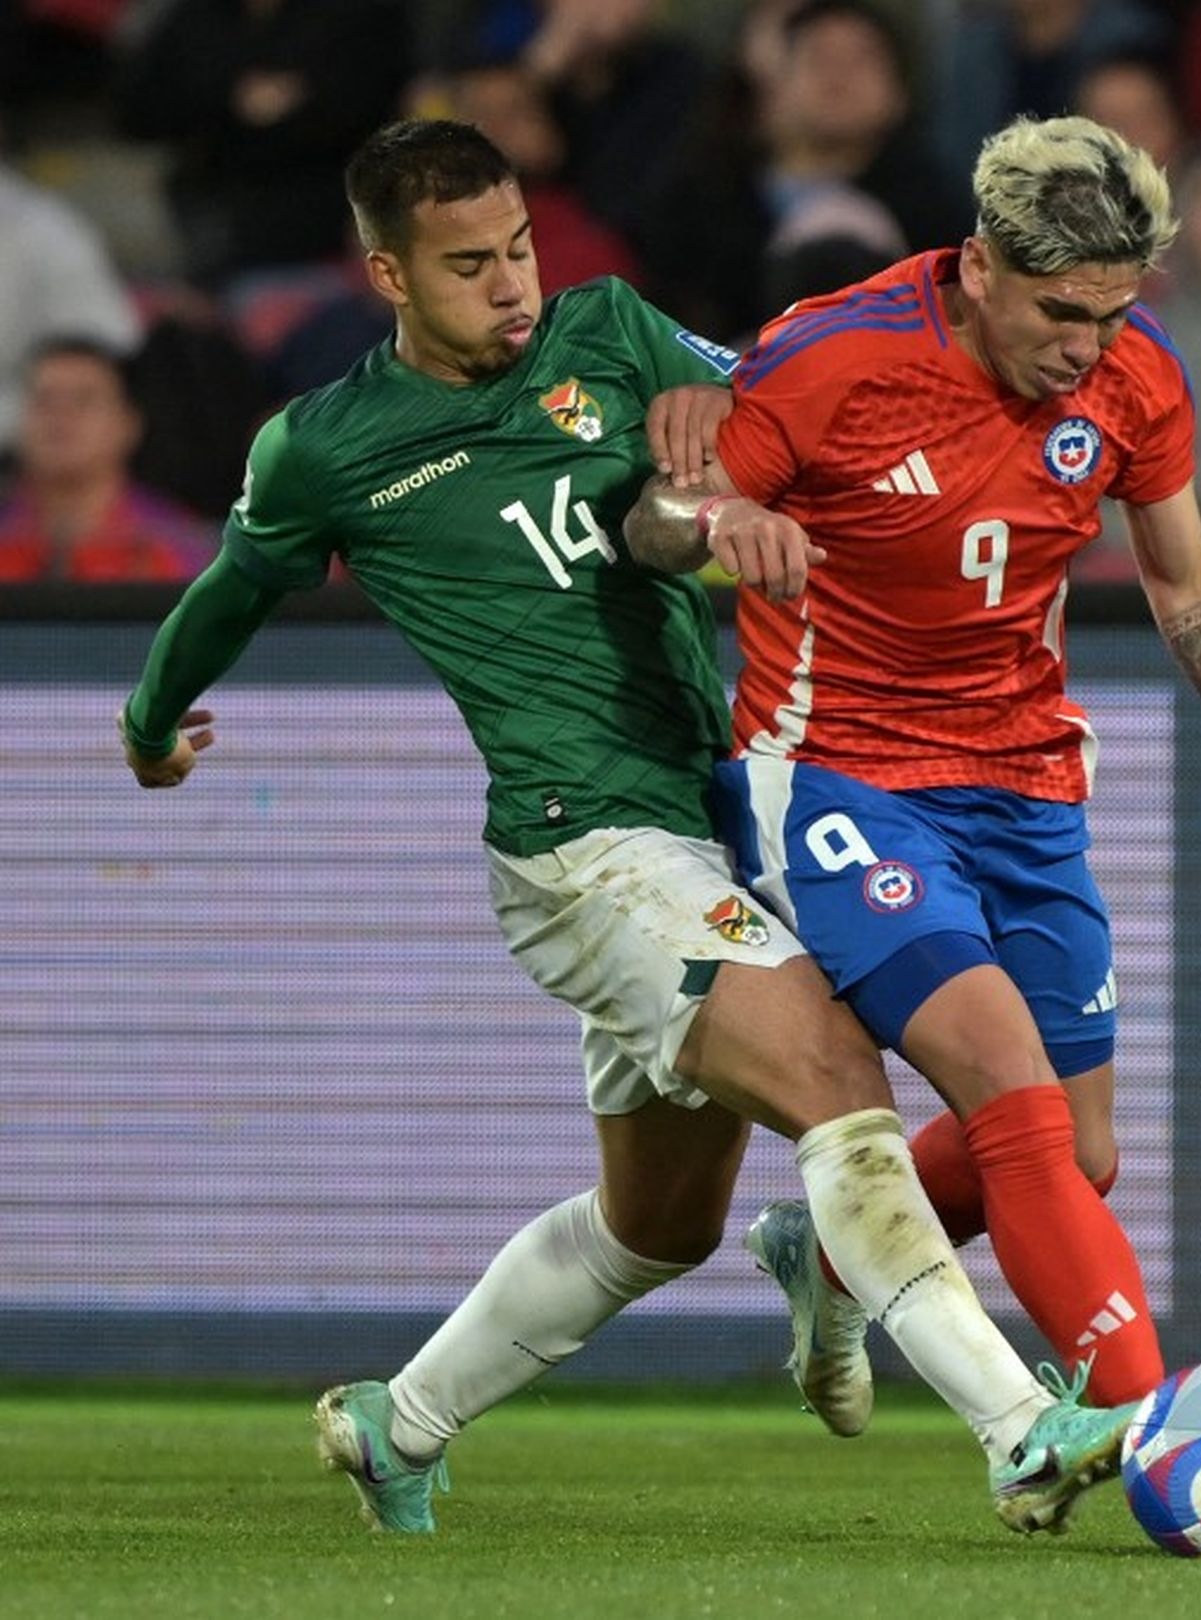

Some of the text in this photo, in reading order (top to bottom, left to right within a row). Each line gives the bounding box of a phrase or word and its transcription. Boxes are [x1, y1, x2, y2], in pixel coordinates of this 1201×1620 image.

[370, 451, 470, 509] marathon
[500, 474, 617, 589] 14
[961, 519, 1010, 608] 9
[805, 812, 880, 873] 9
